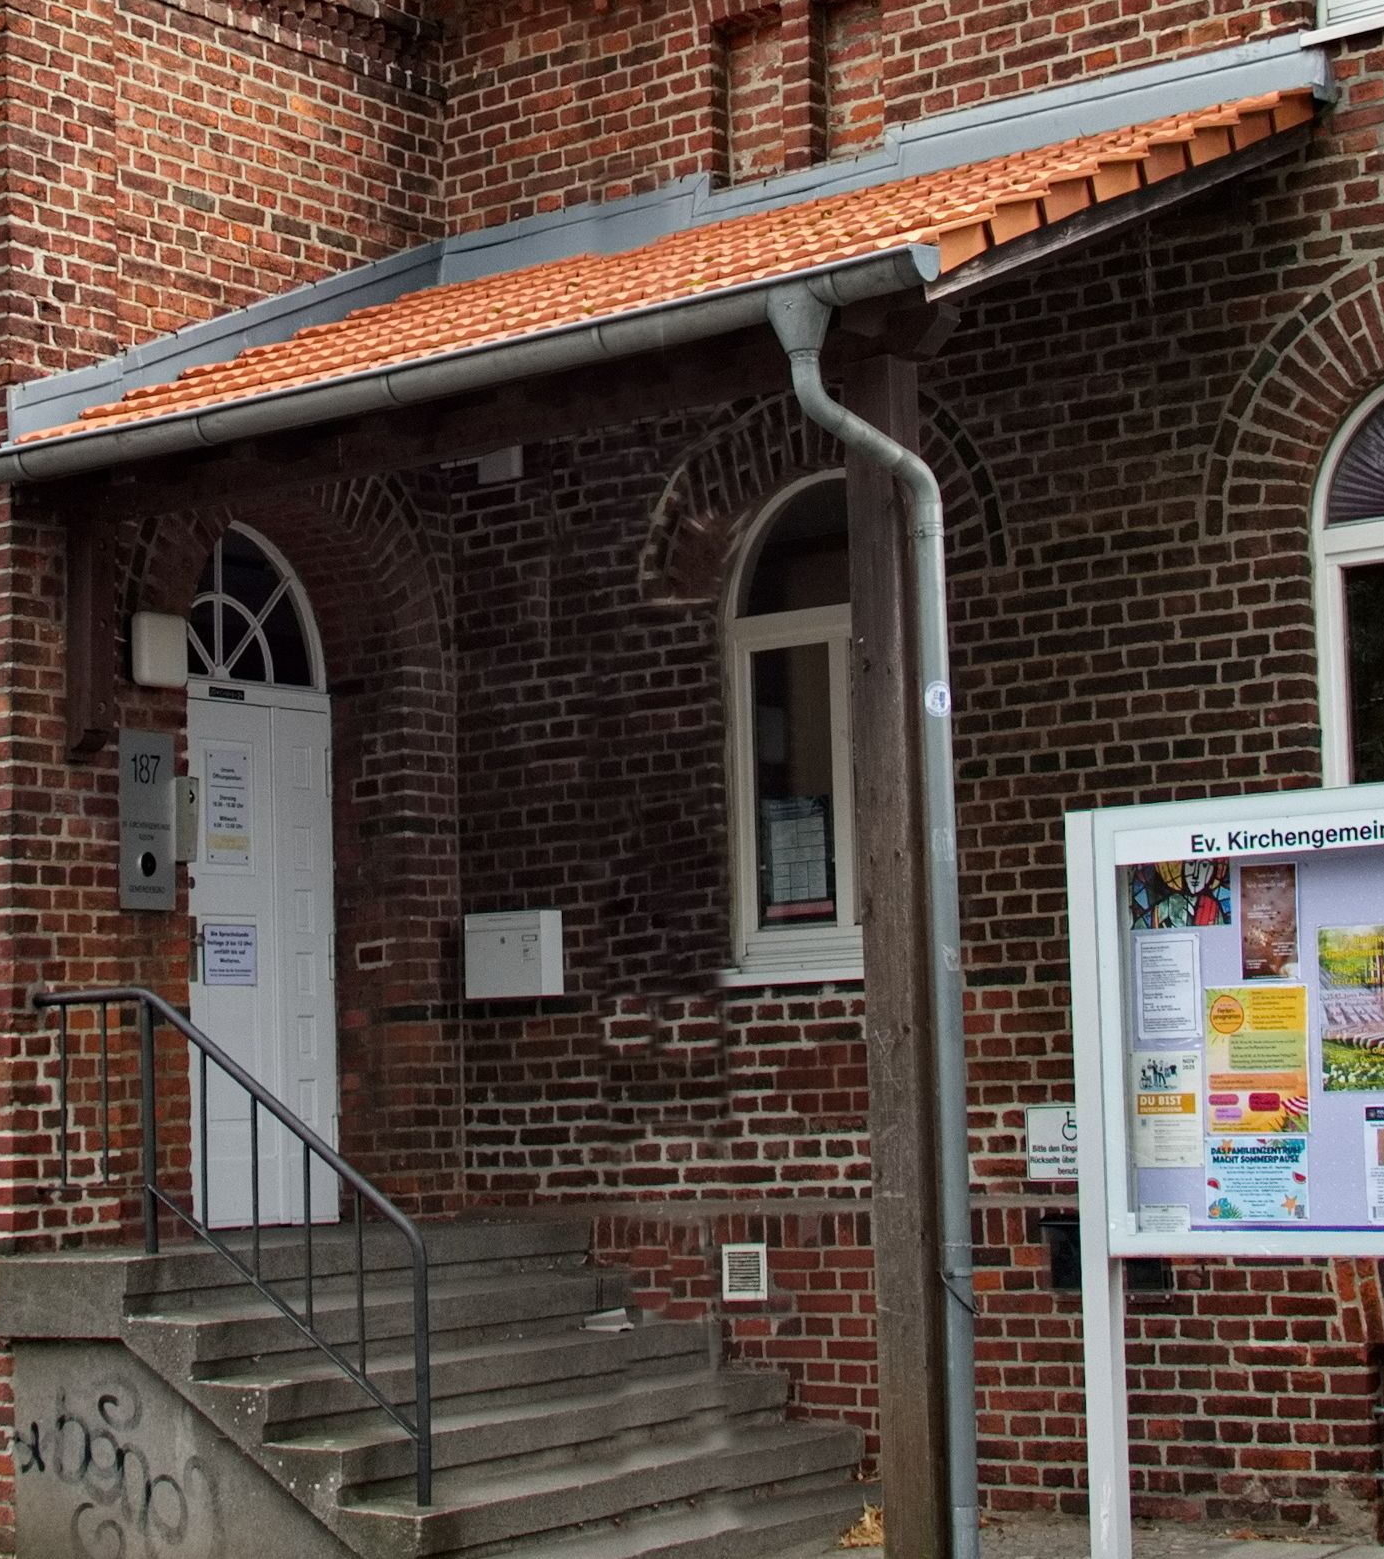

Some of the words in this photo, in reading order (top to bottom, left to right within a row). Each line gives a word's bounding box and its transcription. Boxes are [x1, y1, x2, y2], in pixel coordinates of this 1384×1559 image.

[131, 753, 161, 785] 187
[1191, 834, 1221, 853] Ev.
[1139, 1095, 1156, 1106] DU
[1158, 1095, 1183, 1106] BIST
[1032, 1144, 1047, 1153] Bitte
[1048, 1144, 1060, 1153] den
[1210, 1147, 1226, 1155] DAS
[1030, 1155, 1060, 1164] Rückseite
[1062, 1155, 1077, 1164] über
[1212, 1156, 1239, 1164] MACHT
[1240, 1155, 1300, 1164] SOMMERPAUSE
